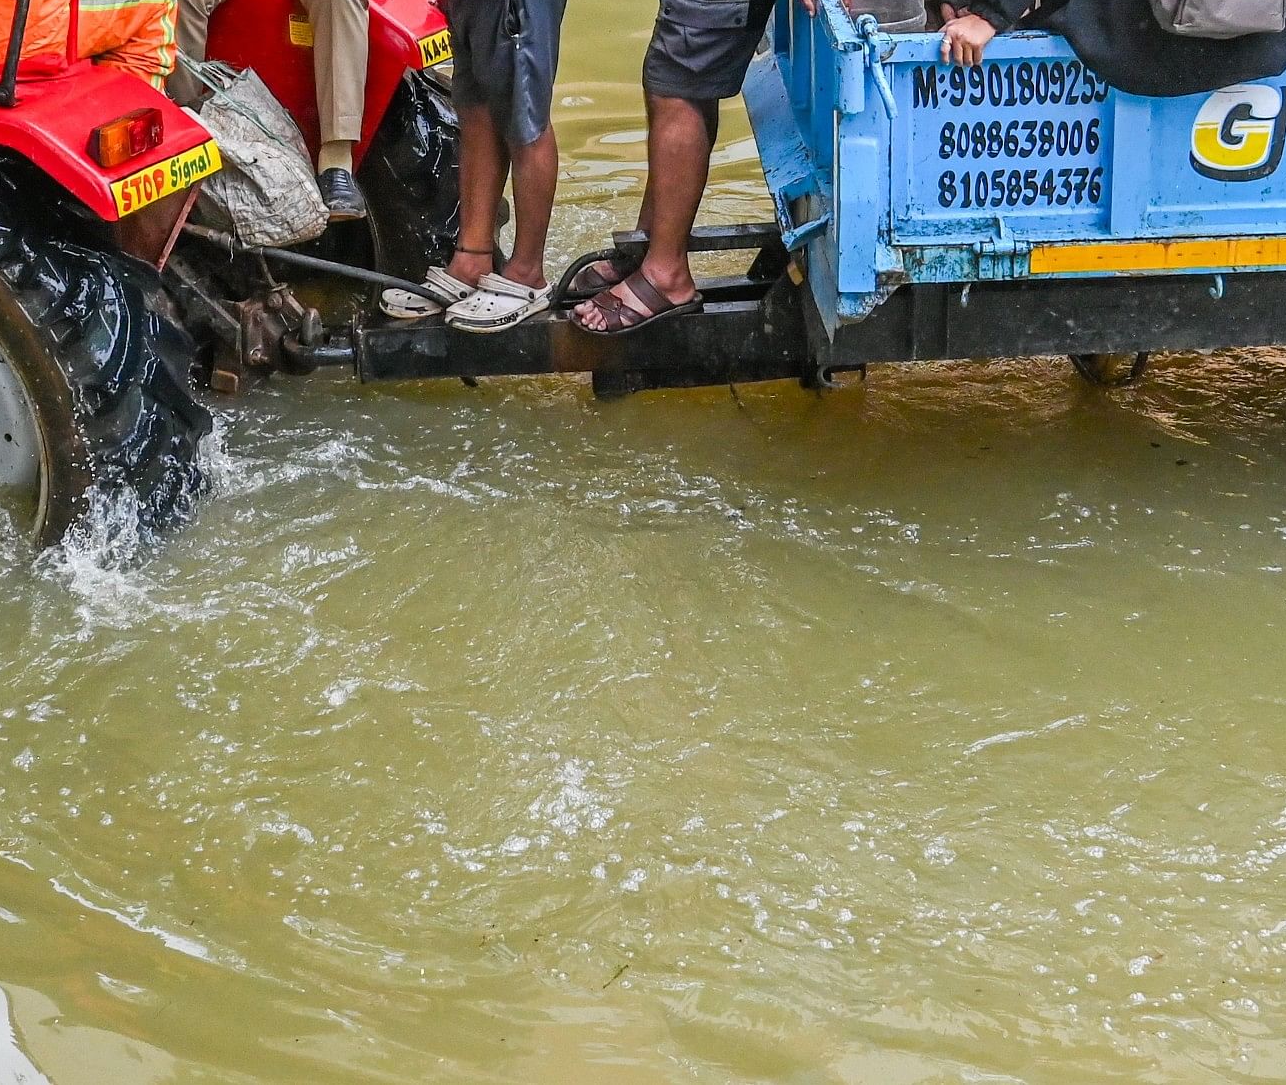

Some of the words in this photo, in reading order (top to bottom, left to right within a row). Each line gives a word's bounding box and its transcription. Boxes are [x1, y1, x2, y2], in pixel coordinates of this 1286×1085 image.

[938, 118, 1100, 159] 8088638006
[121, 168, 165, 212] STOP
[170, 143, 211, 188] Signal
[937, 167, 1104, 208] 8105854376
